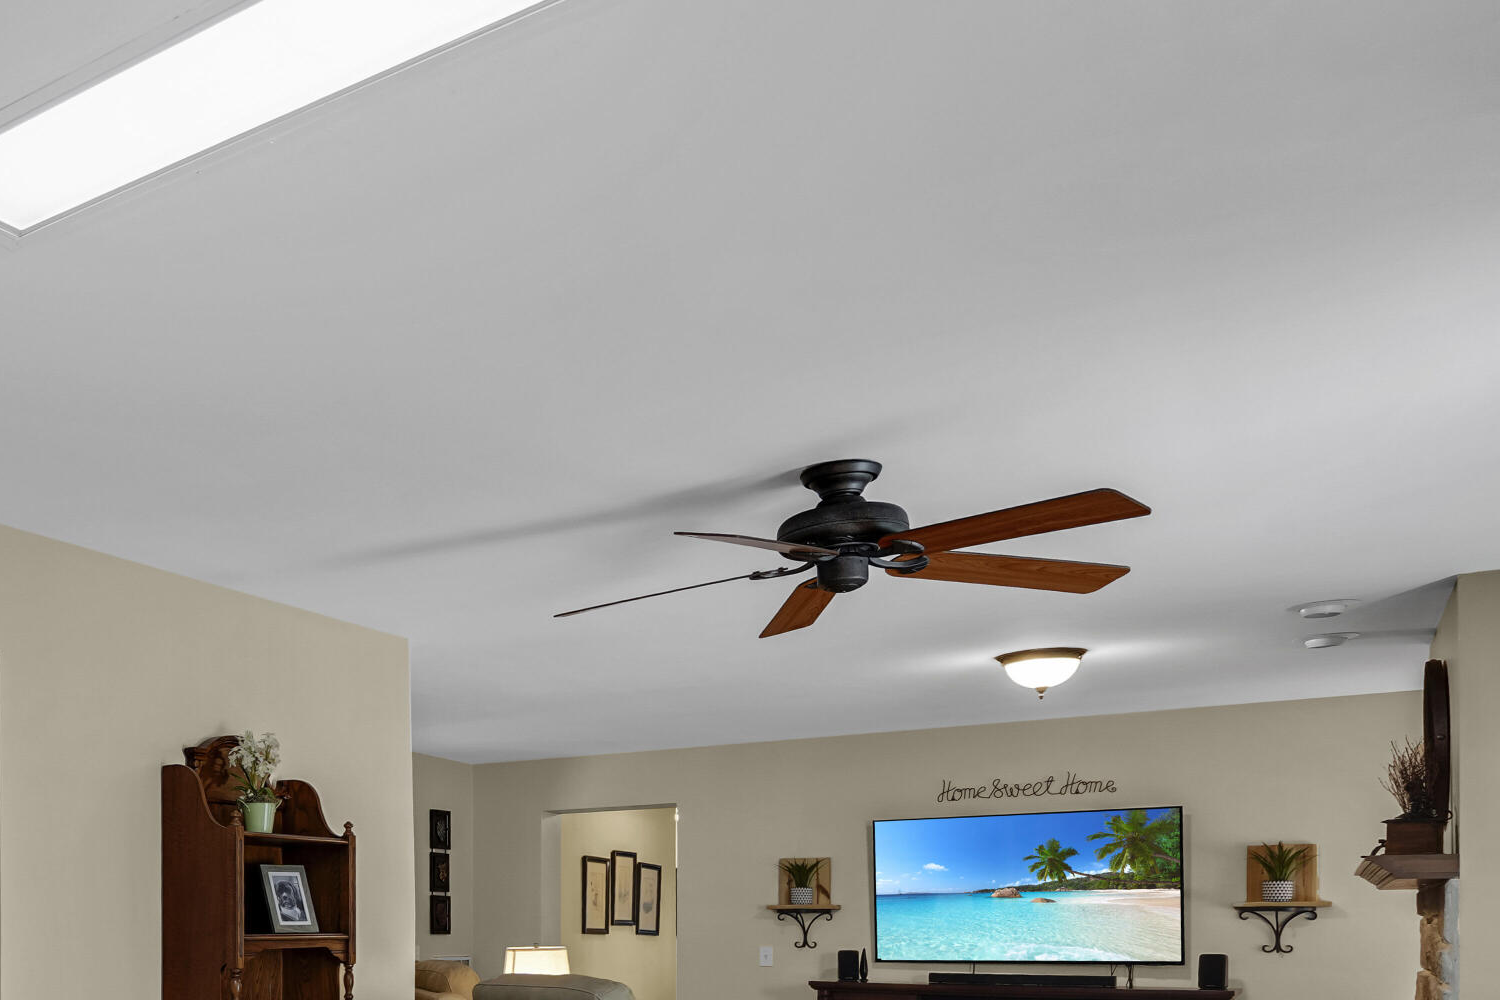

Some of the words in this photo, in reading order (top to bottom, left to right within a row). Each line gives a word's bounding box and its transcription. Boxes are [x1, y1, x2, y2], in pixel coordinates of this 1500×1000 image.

[937, 779, 988, 803] Home
[989, 776, 1056, 799] Sweet
[1060, 771, 1117, 796] Home
